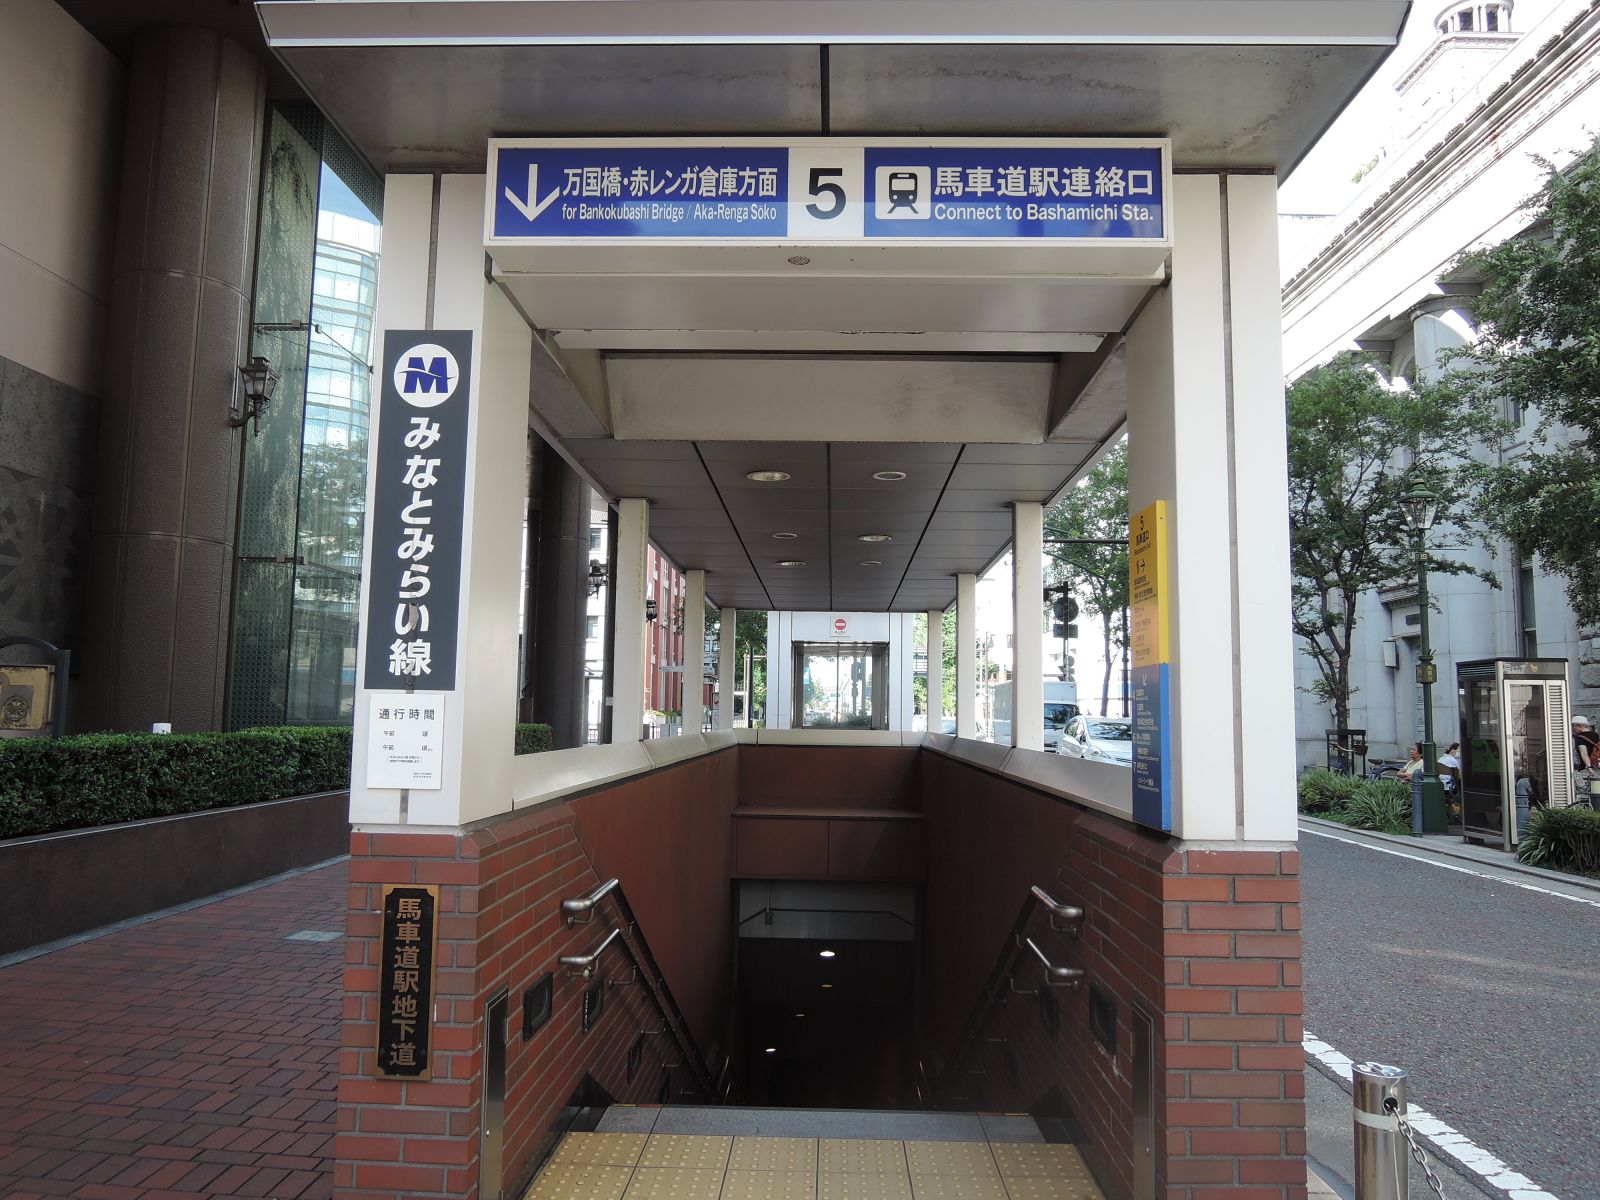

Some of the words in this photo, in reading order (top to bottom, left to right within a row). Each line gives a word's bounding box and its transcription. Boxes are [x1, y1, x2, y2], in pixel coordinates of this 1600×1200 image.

[562, 166, 778, 197] 万国橋・赤レンガ倉庫方面
[805, 168, 847, 220] 5
[934, 166, 1153, 197] 馬車道駅連絡口
[562, 203, 577, 220] for
[580, 203, 650, 220] Bankokubashi
[651, 203, 684, 223] Bridge
[693, 203, 749, 223] Aka-Renga
[934, 203, 1002, 220] Connect
[1005, 204, 1023, 220] to
[1026, 203, 1118, 220] Bashamichi
[1121, 203, 1154, 221] Sta.
[388, 417, 441, 676] みなとみらい線
[379, 708, 435, 720] 通行時間
[389, 898, 422, 1066] 馬車道駅地下道
